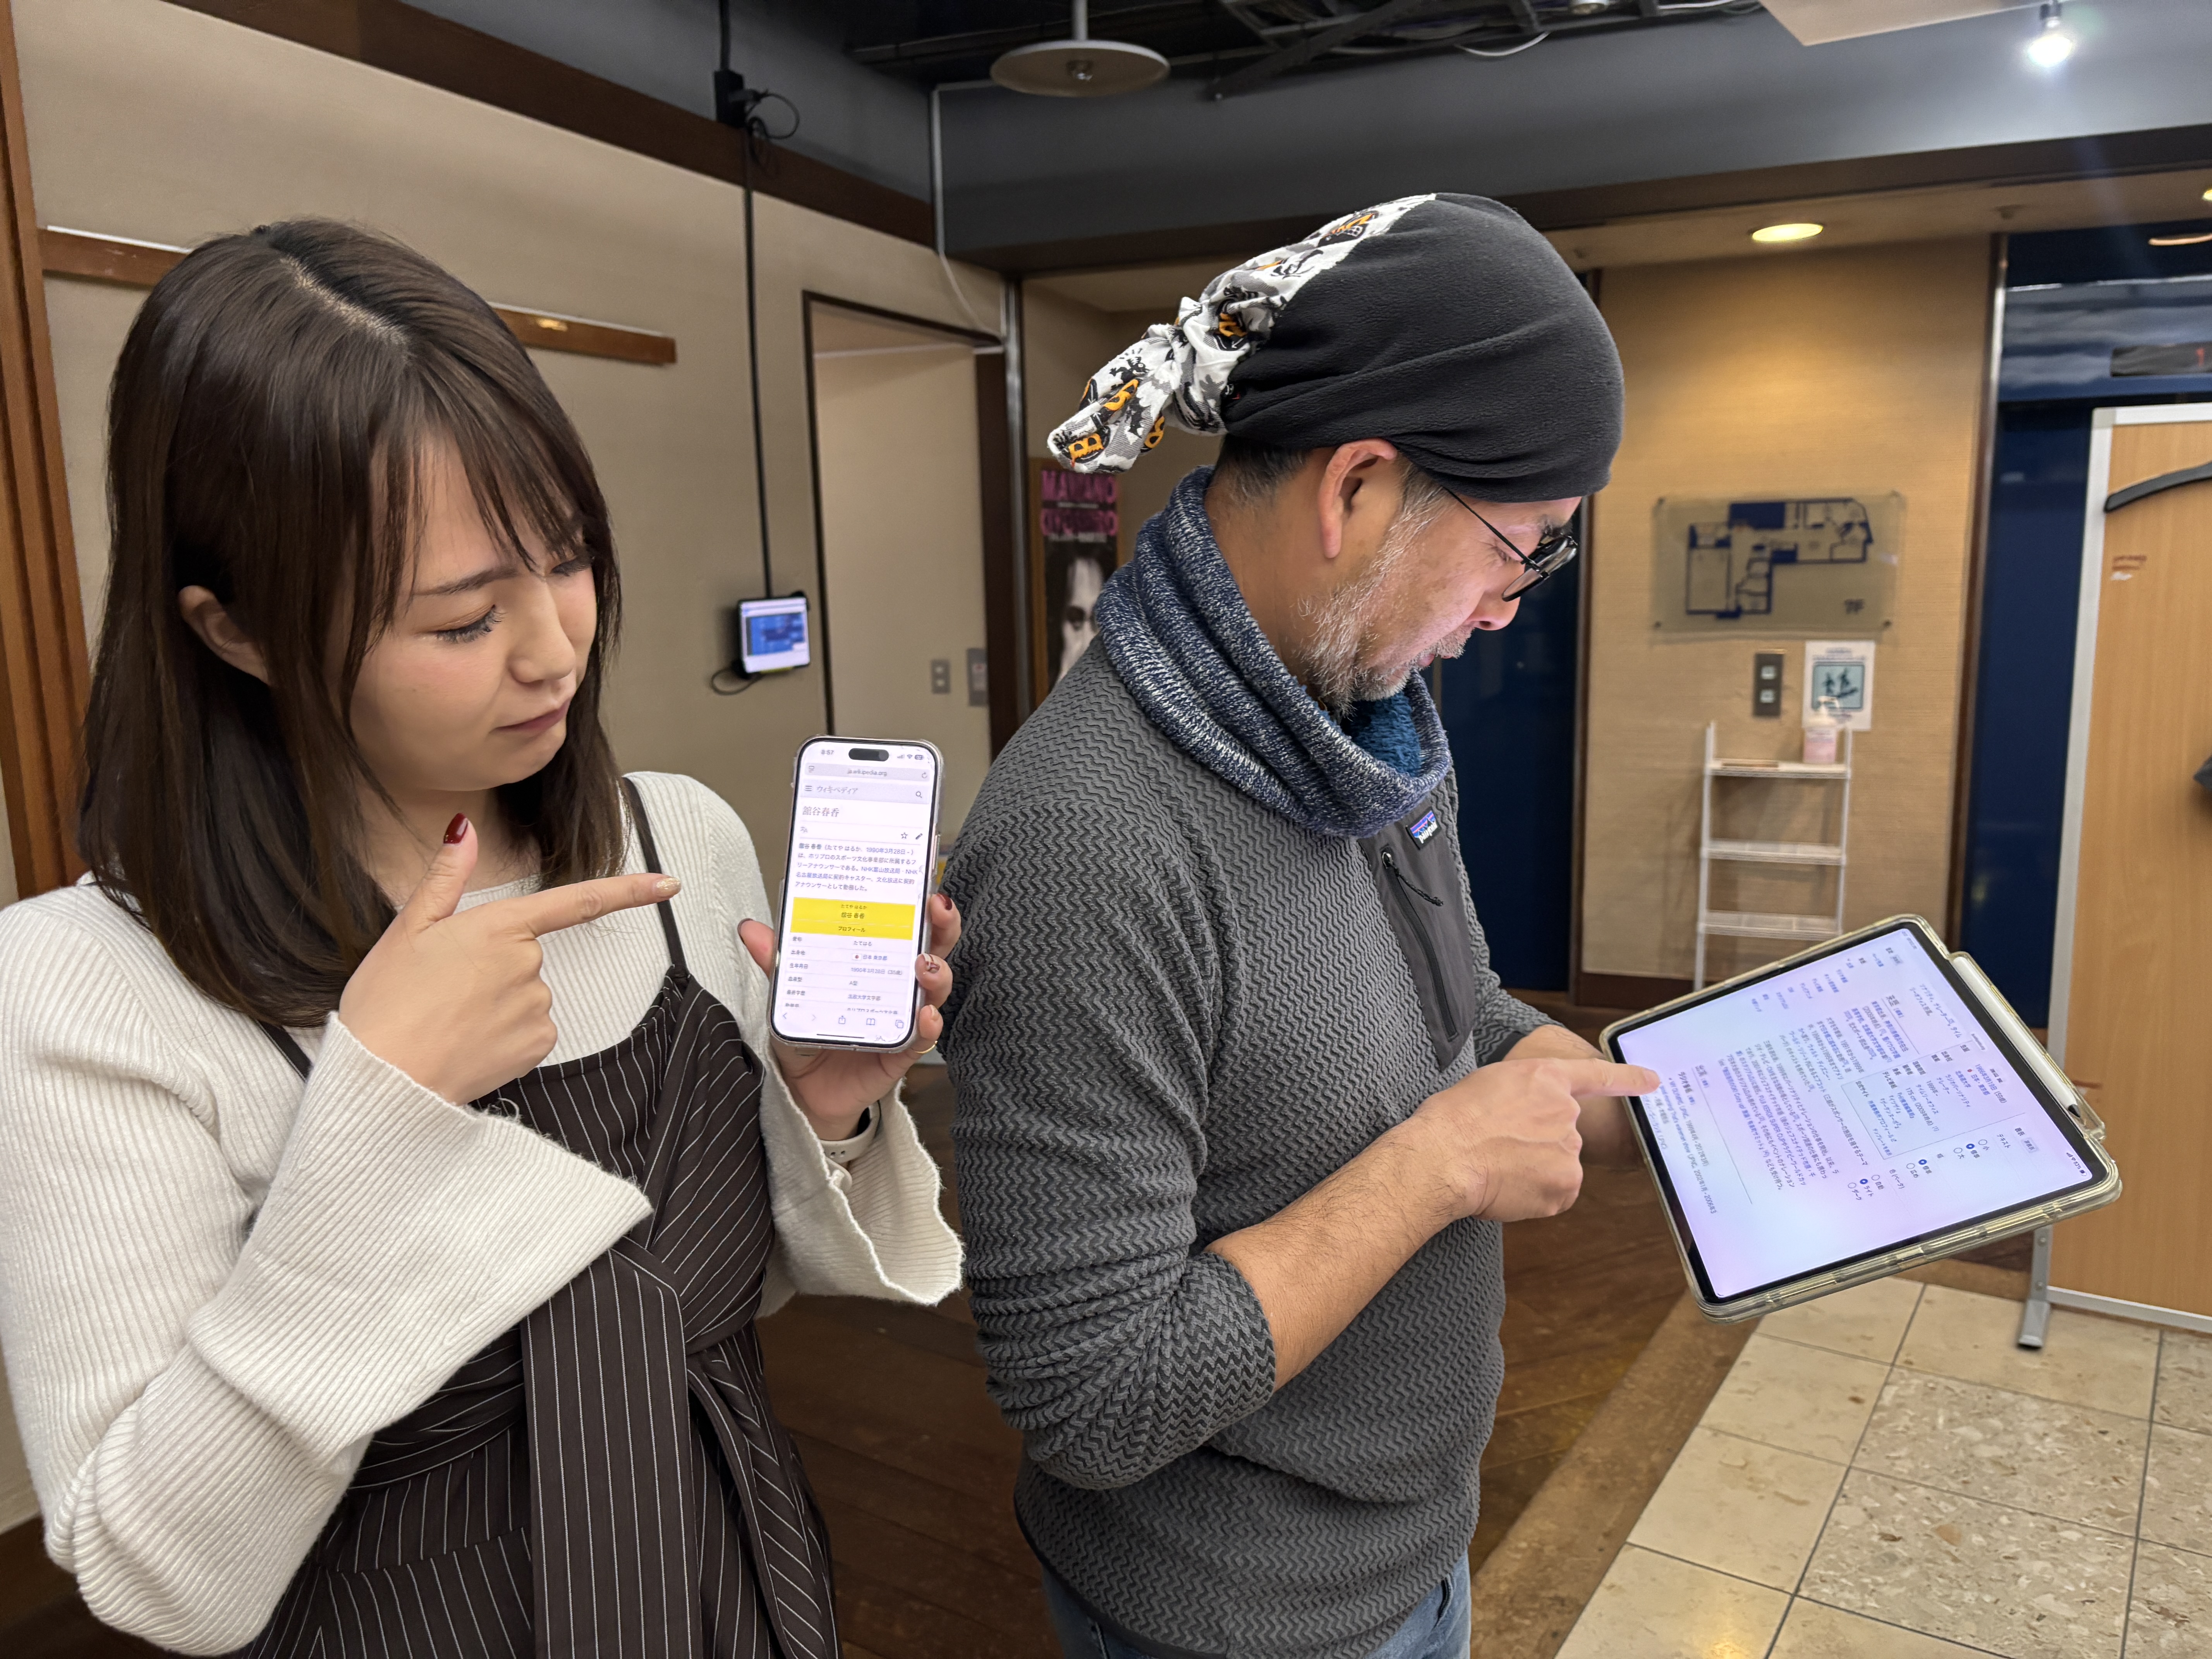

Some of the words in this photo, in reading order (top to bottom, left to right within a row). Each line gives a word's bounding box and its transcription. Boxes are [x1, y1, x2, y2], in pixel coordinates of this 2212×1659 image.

[816, 785, 858, 794] ウィキペディア
[1996, 1133, 2011, 1149] テキスト
[1851, 1188, 1863, 1201] ダーク
[1863, 1185, 1874, 1197] ライト
